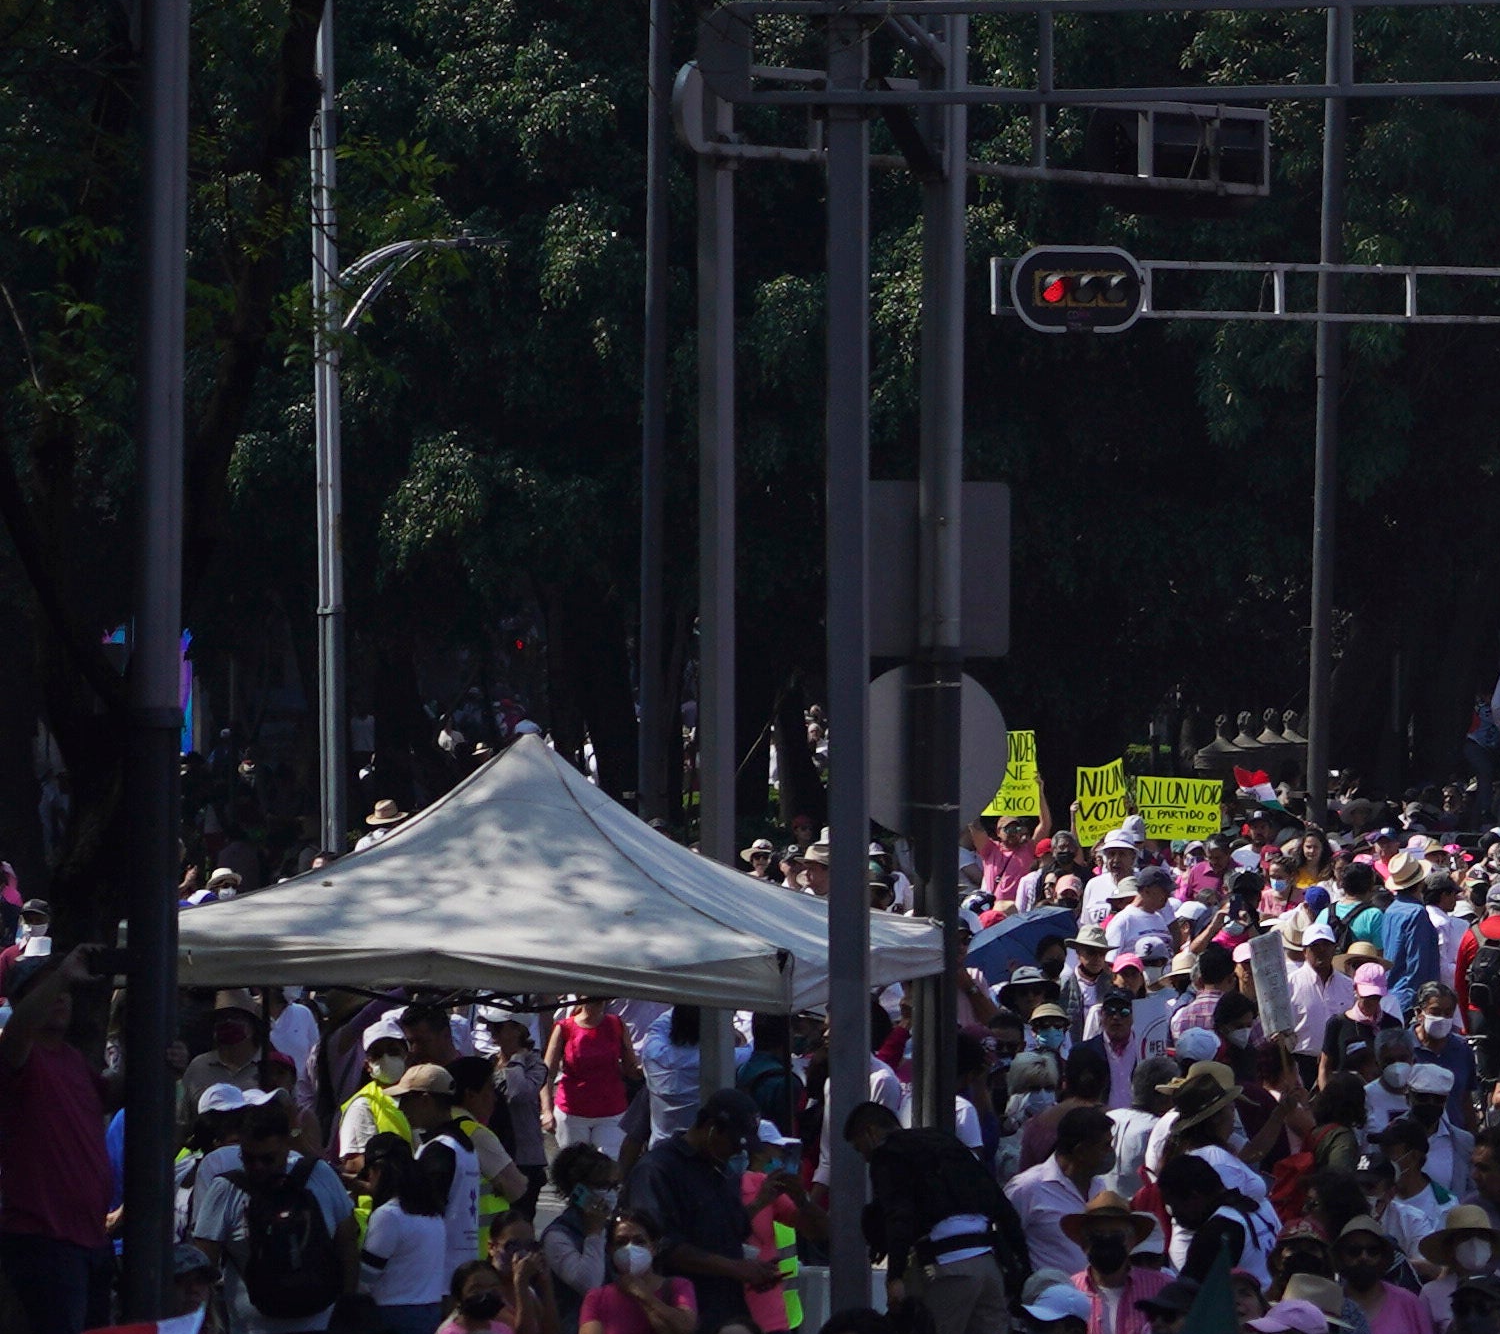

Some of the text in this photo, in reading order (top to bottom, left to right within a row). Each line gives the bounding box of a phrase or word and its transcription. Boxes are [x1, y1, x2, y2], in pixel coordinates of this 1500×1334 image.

[1080, 763, 1124, 797] NI UN
[1139, 780, 1223, 805] NI UN VOTO
[1078, 796, 1126, 822] VOTO
[1157, 810, 1205, 820] PARTIDO
